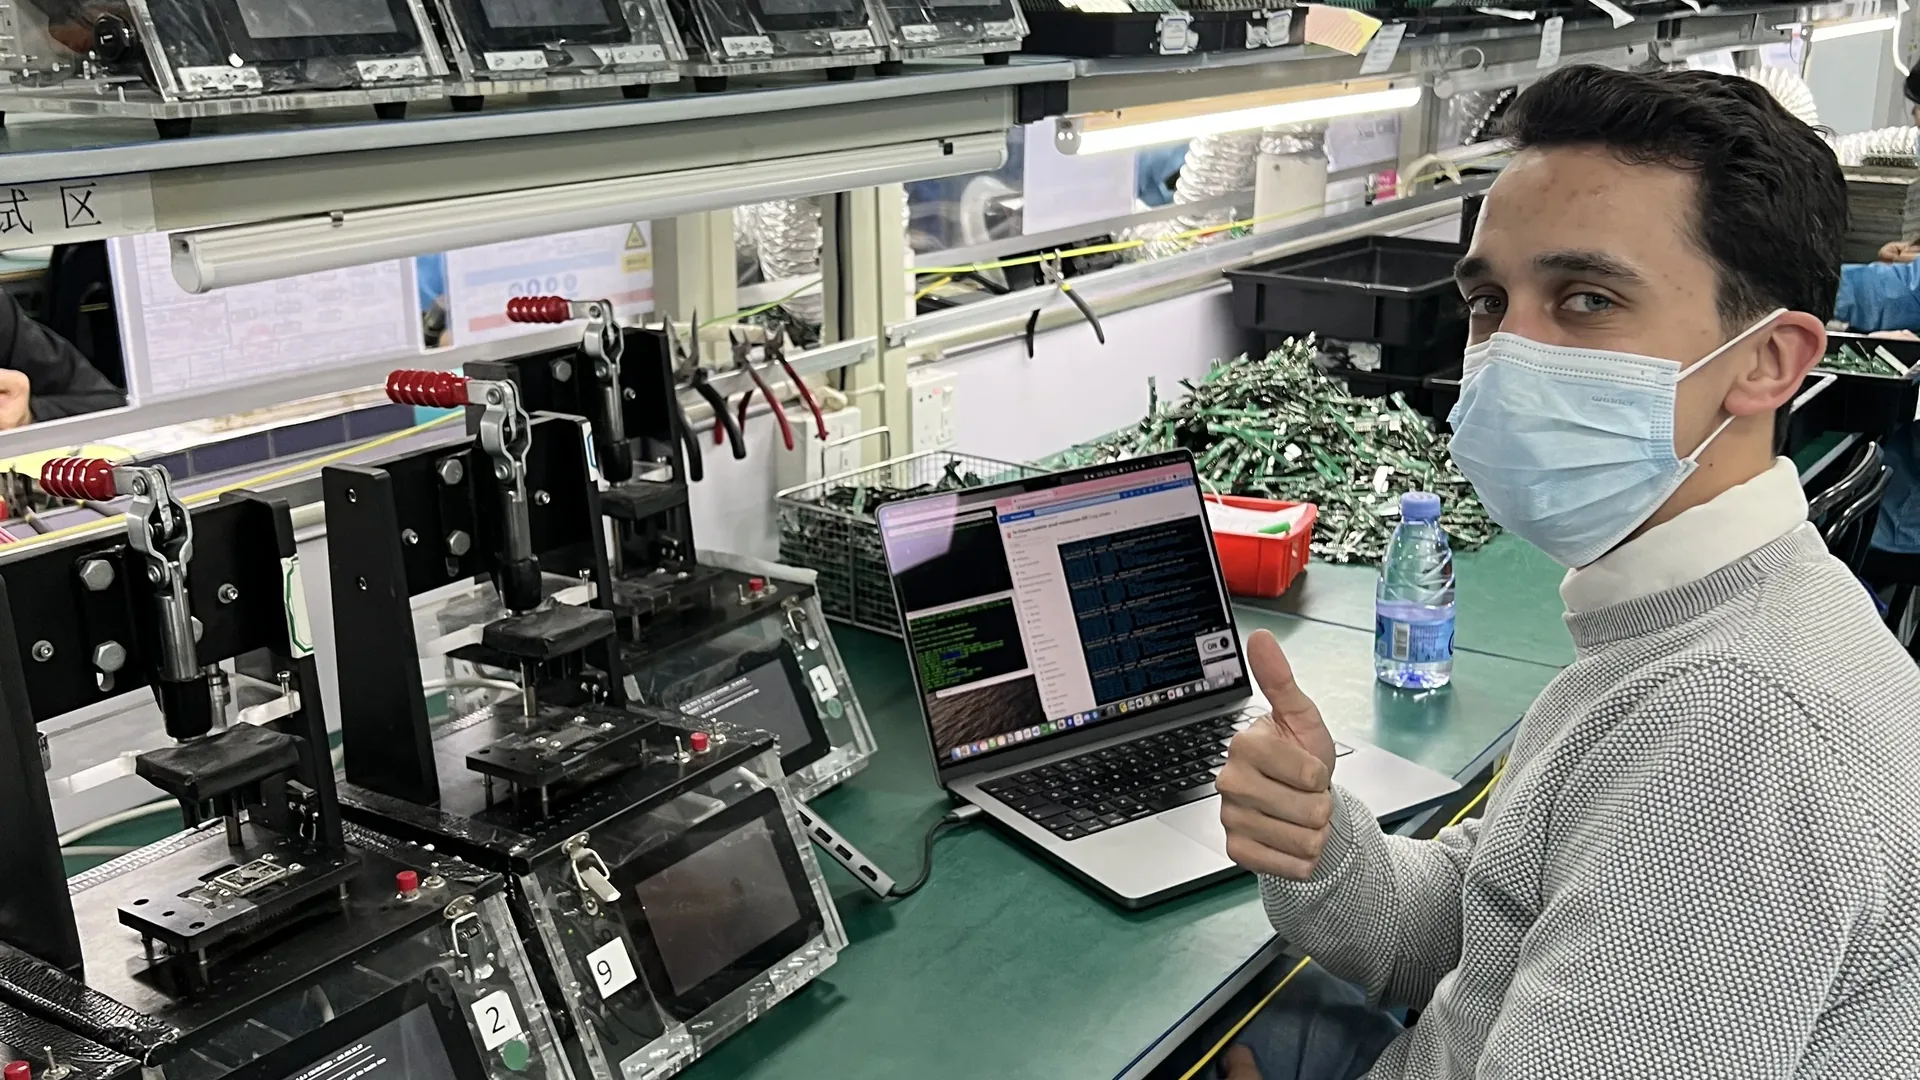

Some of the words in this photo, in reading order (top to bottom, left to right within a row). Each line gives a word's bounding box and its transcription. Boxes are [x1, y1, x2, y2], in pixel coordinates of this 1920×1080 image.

[1591, 393, 1636, 406] winner
[816, 676, 828, 691] 1
[597, 960, 612, 985] 9
[485, 1006, 506, 1034] 2
